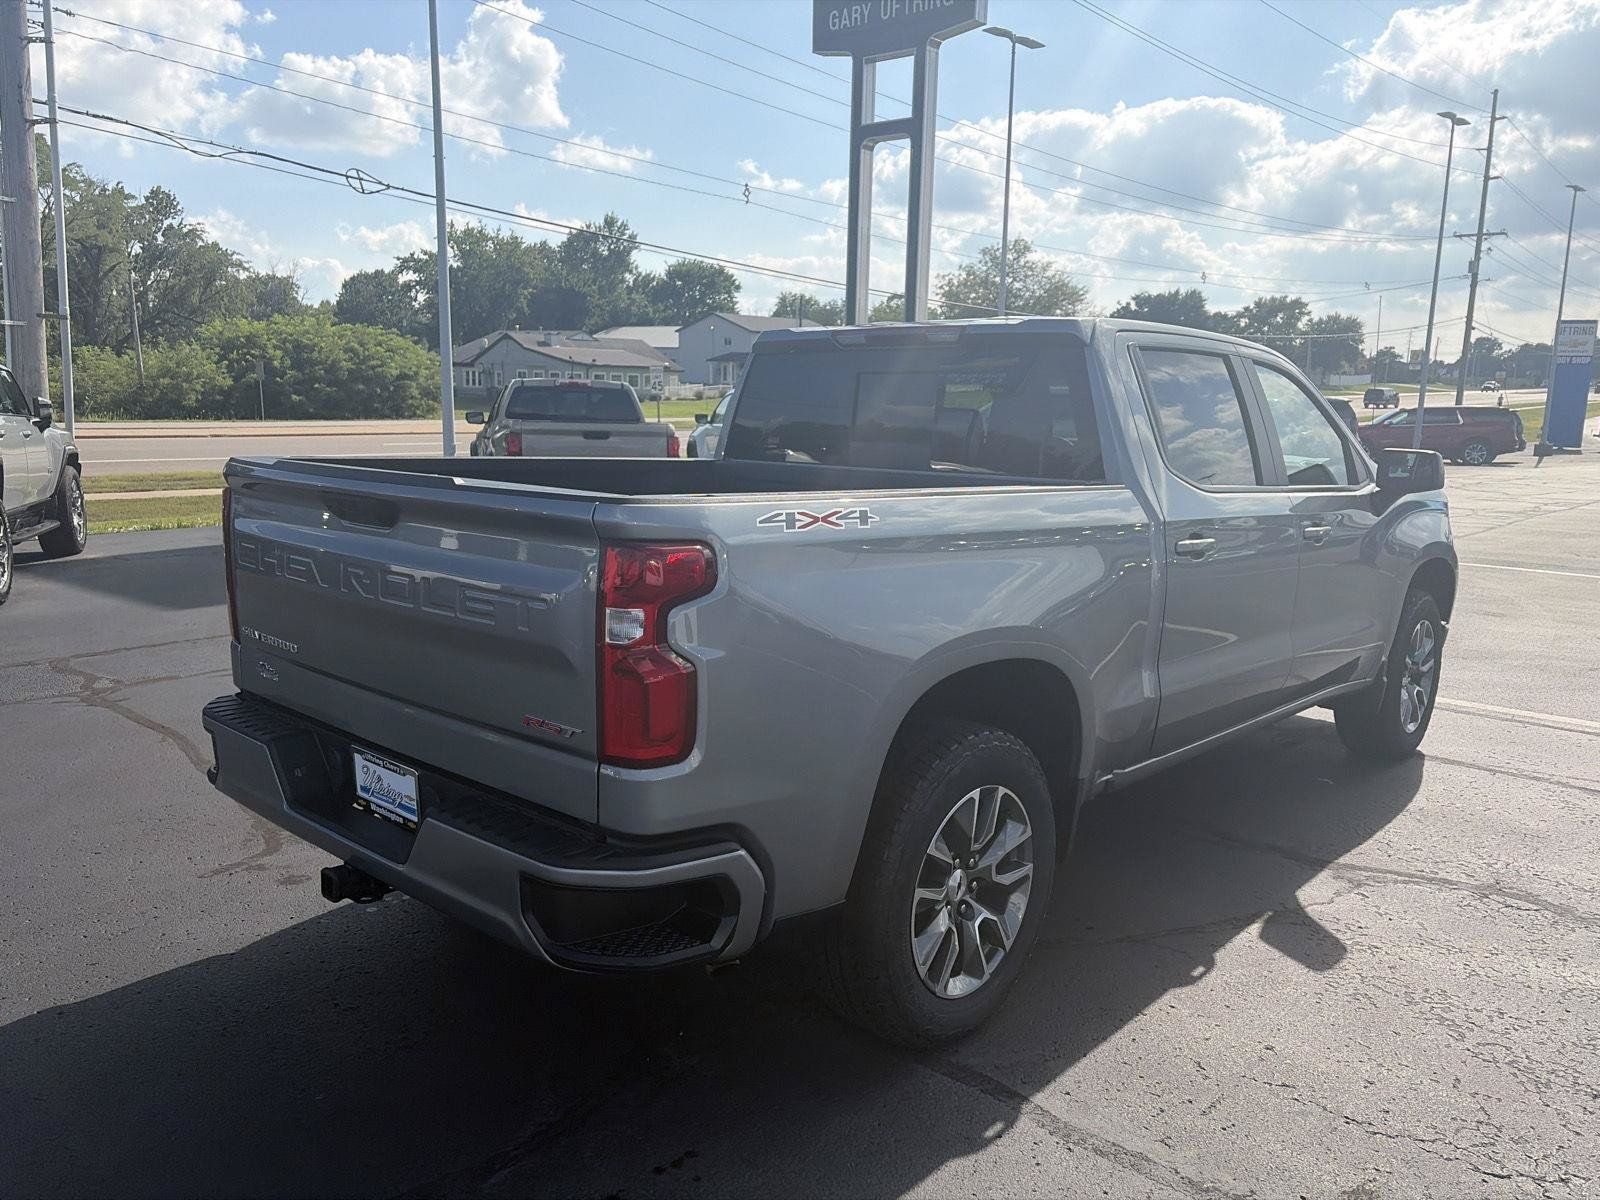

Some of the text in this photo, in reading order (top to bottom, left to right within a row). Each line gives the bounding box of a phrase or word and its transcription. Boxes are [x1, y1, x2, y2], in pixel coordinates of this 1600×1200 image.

[829, 3, 872, 31] GARY
[652, 381, 664, 392] 45
[237, 541, 550, 631] CHEVROLET
[242, 626, 298, 652] SILVERADO
[522, 715, 583, 738] RST
[370, 802, 404, 824] Washington
